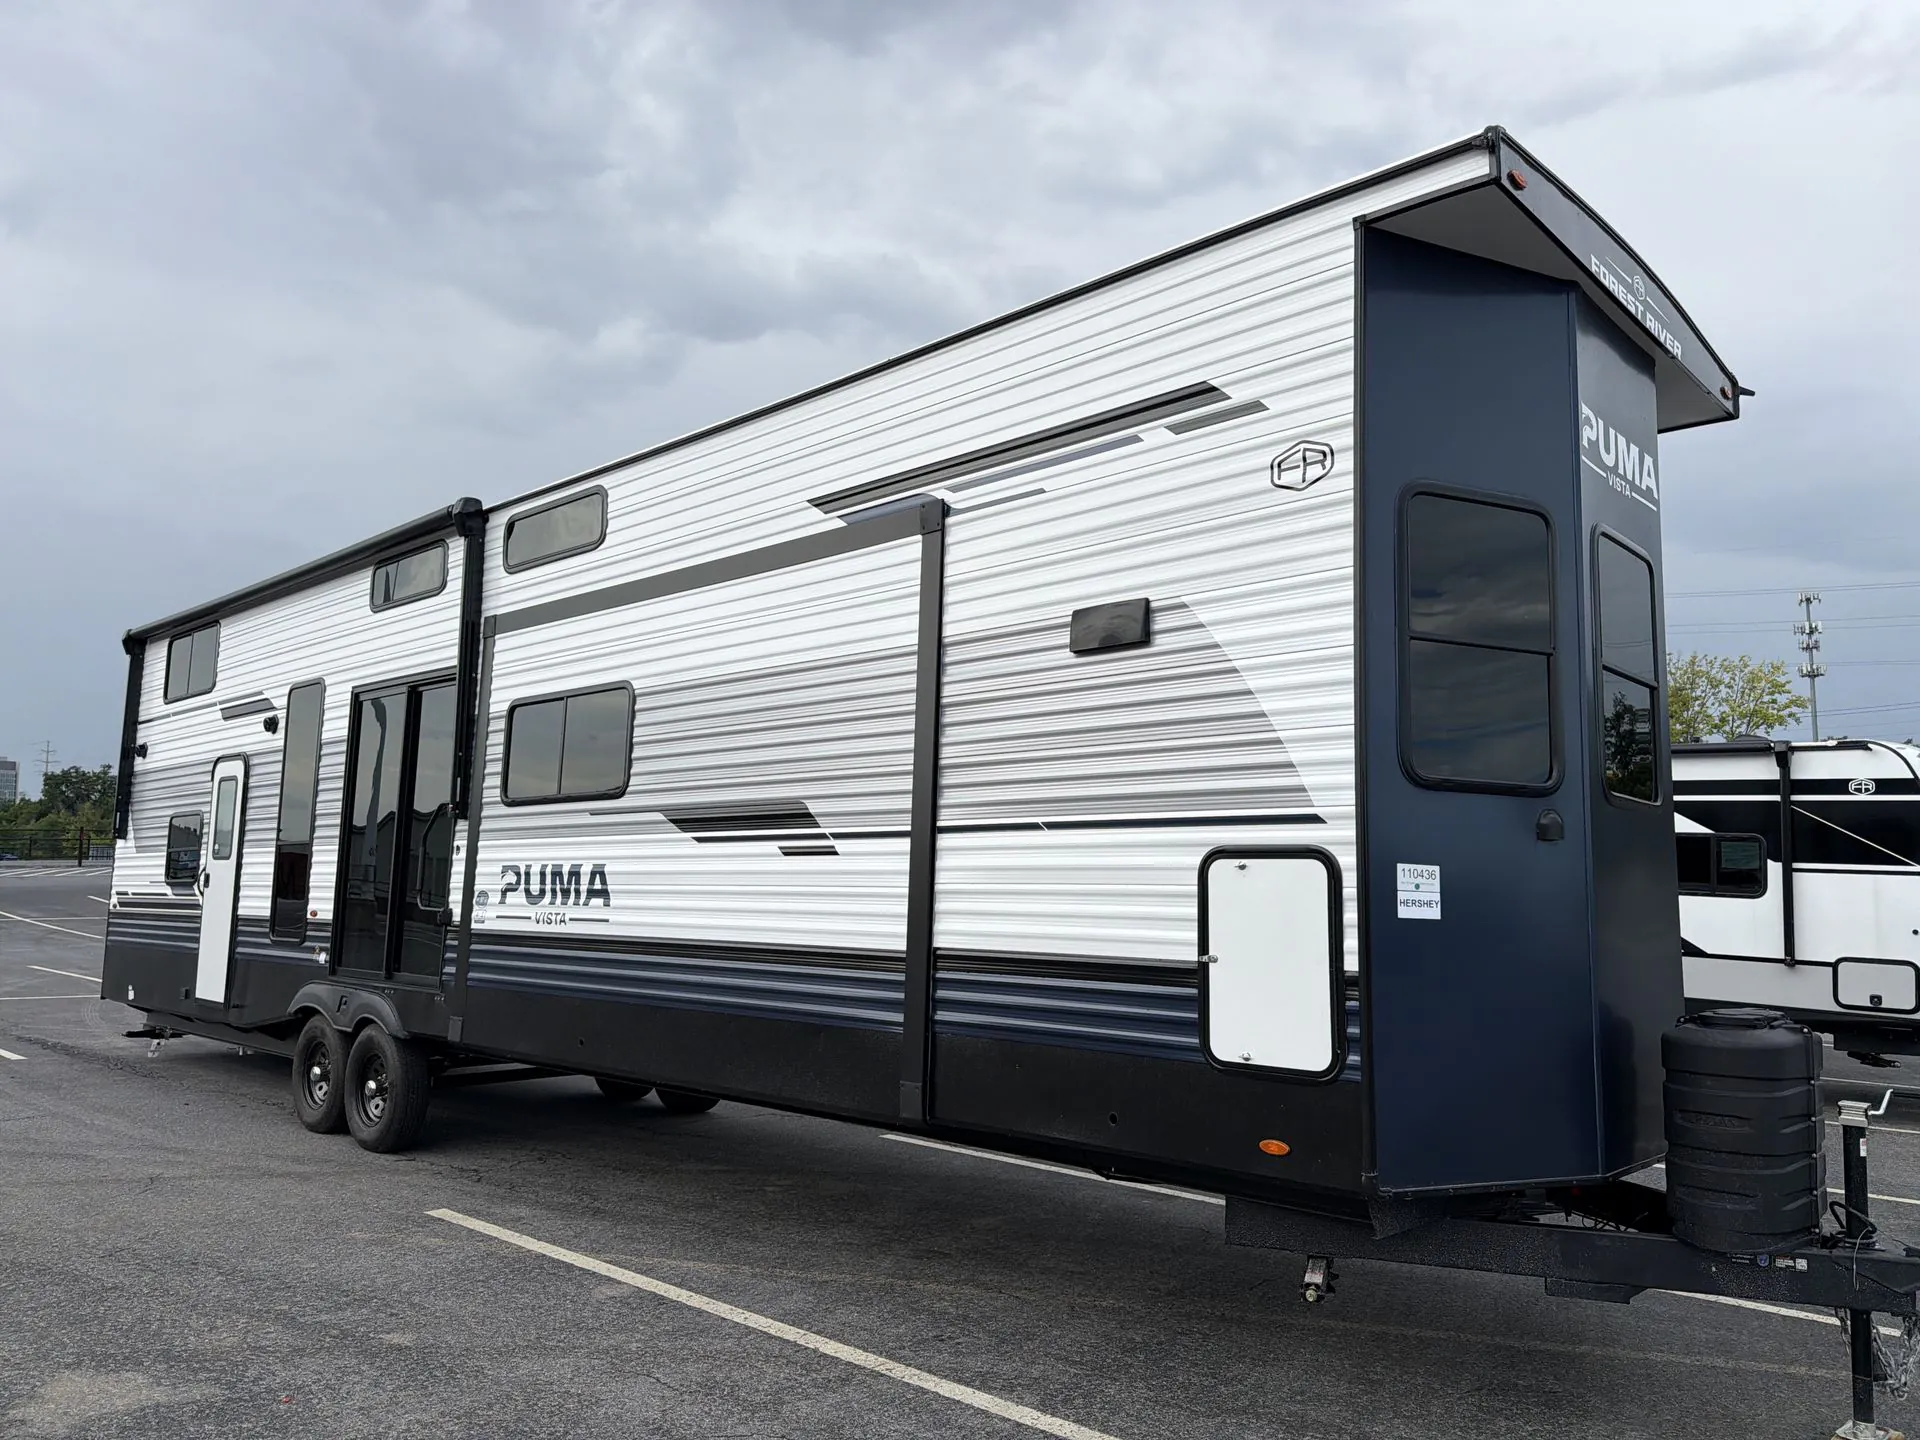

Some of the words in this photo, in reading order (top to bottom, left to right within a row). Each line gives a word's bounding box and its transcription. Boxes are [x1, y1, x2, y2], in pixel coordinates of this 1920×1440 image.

[1591, 254, 1644, 320] FOREST
[1646, 311, 1682, 360] RIVER
[1581, 401, 1658, 500] PUMA
[1607, 470, 1631, 499] VISTA
[498, 864, 611, 907] PUMA
[1401, 868, 1437, 881] 110436
[534, 912, 567, 925] VISTA
[1400, 899, 1440, 909] HERSHEY
